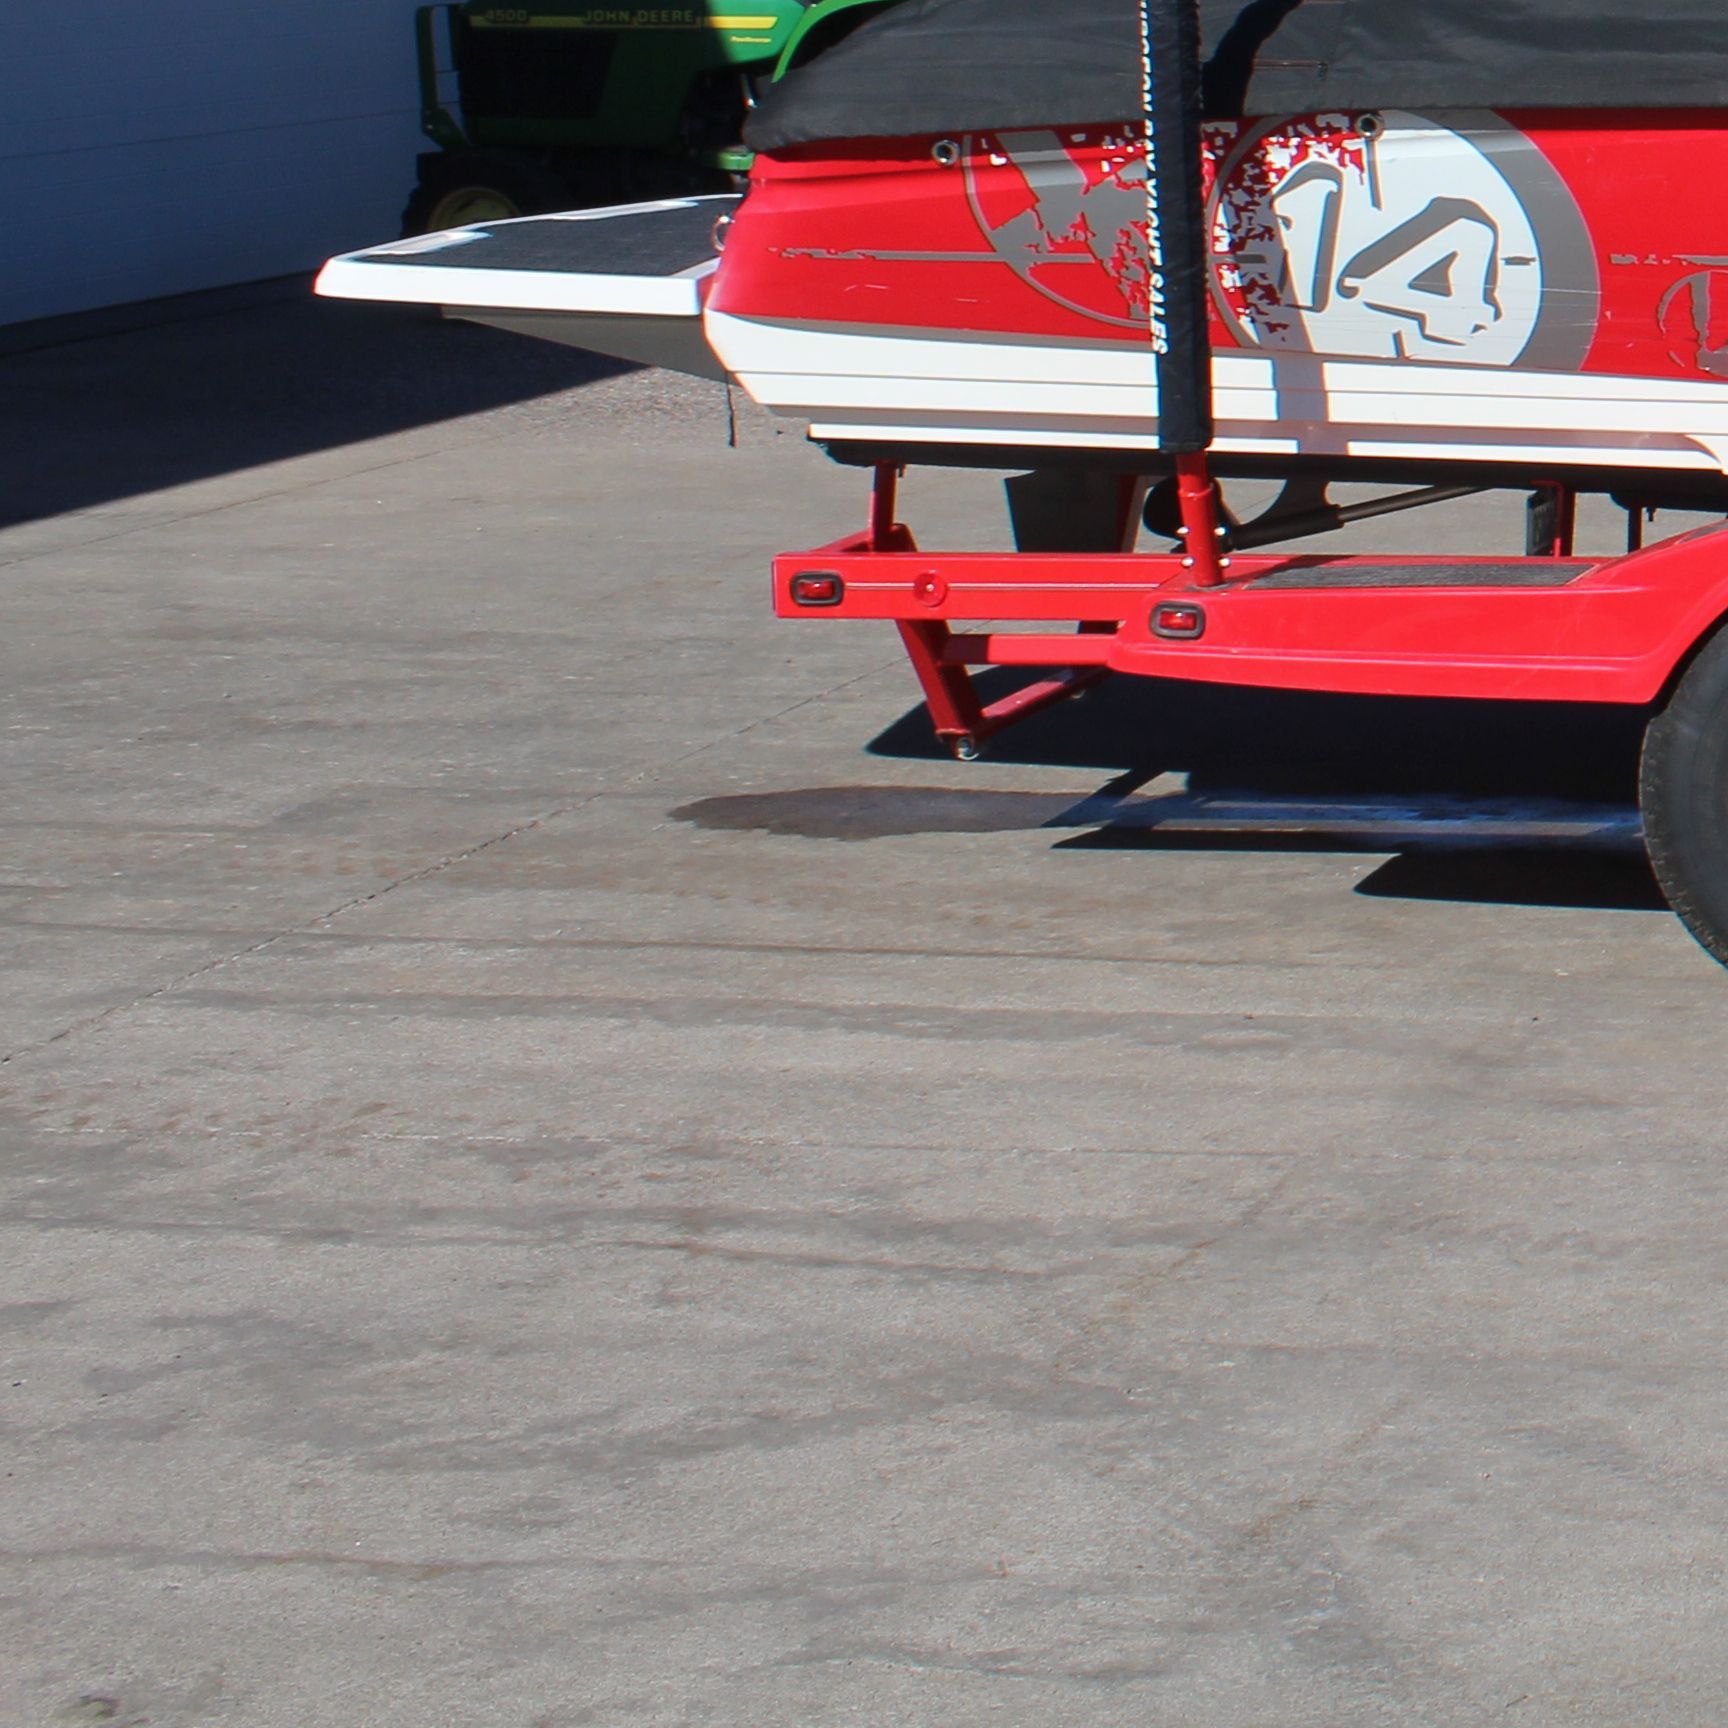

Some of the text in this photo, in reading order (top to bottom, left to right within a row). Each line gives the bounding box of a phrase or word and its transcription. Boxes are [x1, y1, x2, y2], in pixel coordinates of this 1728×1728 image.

[584, 9, 694, 22] JOHN DEERE
[1150, 273, 1169, 355] SALES
